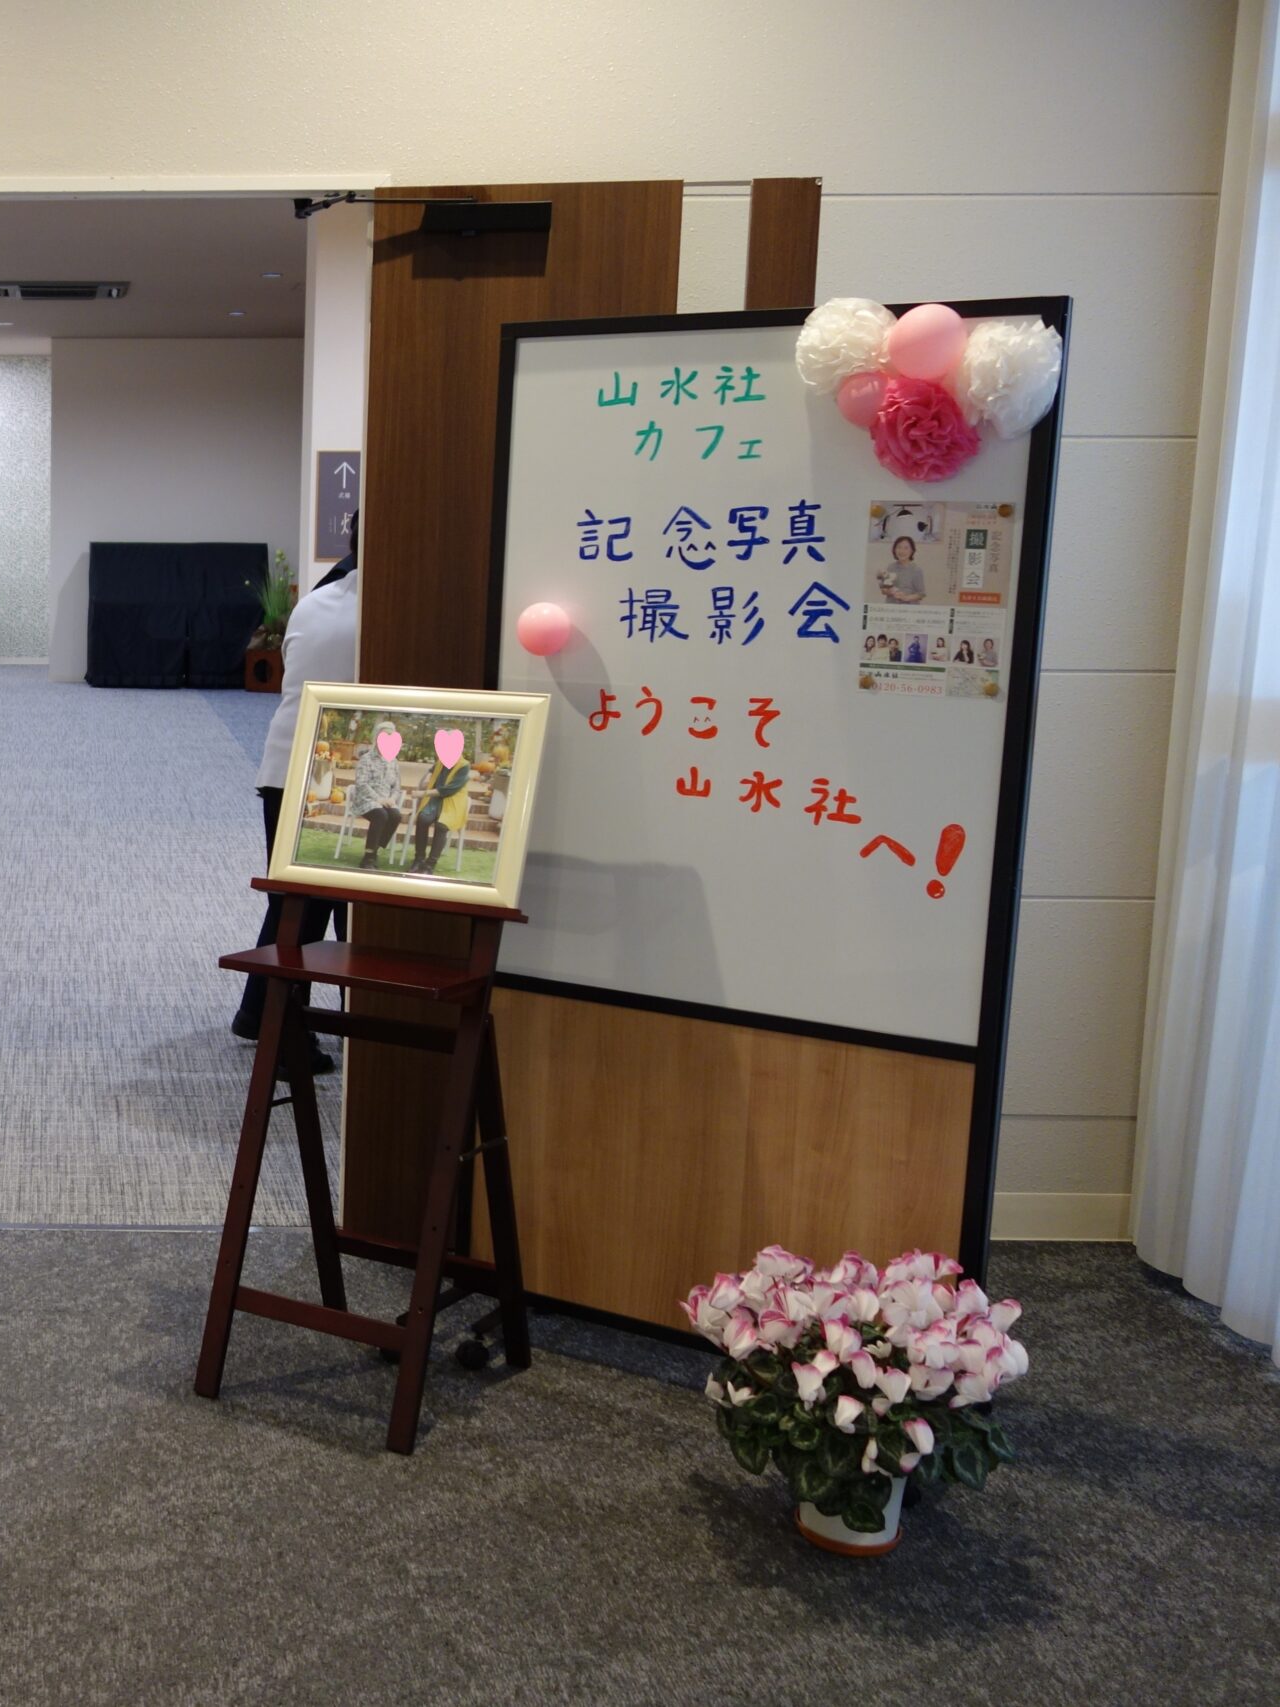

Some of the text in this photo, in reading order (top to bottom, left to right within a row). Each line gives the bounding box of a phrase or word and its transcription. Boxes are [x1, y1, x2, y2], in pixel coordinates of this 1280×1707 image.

[596, 365, 767, 408] 山水社
[635, 420, 763, 461] カフェ
[577, 499, 827, 570] 記念写真
[967, 532, 985, 585] 撮影会
[620, 581, 851, 646] 撮影会
[588, 687, 782, 748] ようこそ
